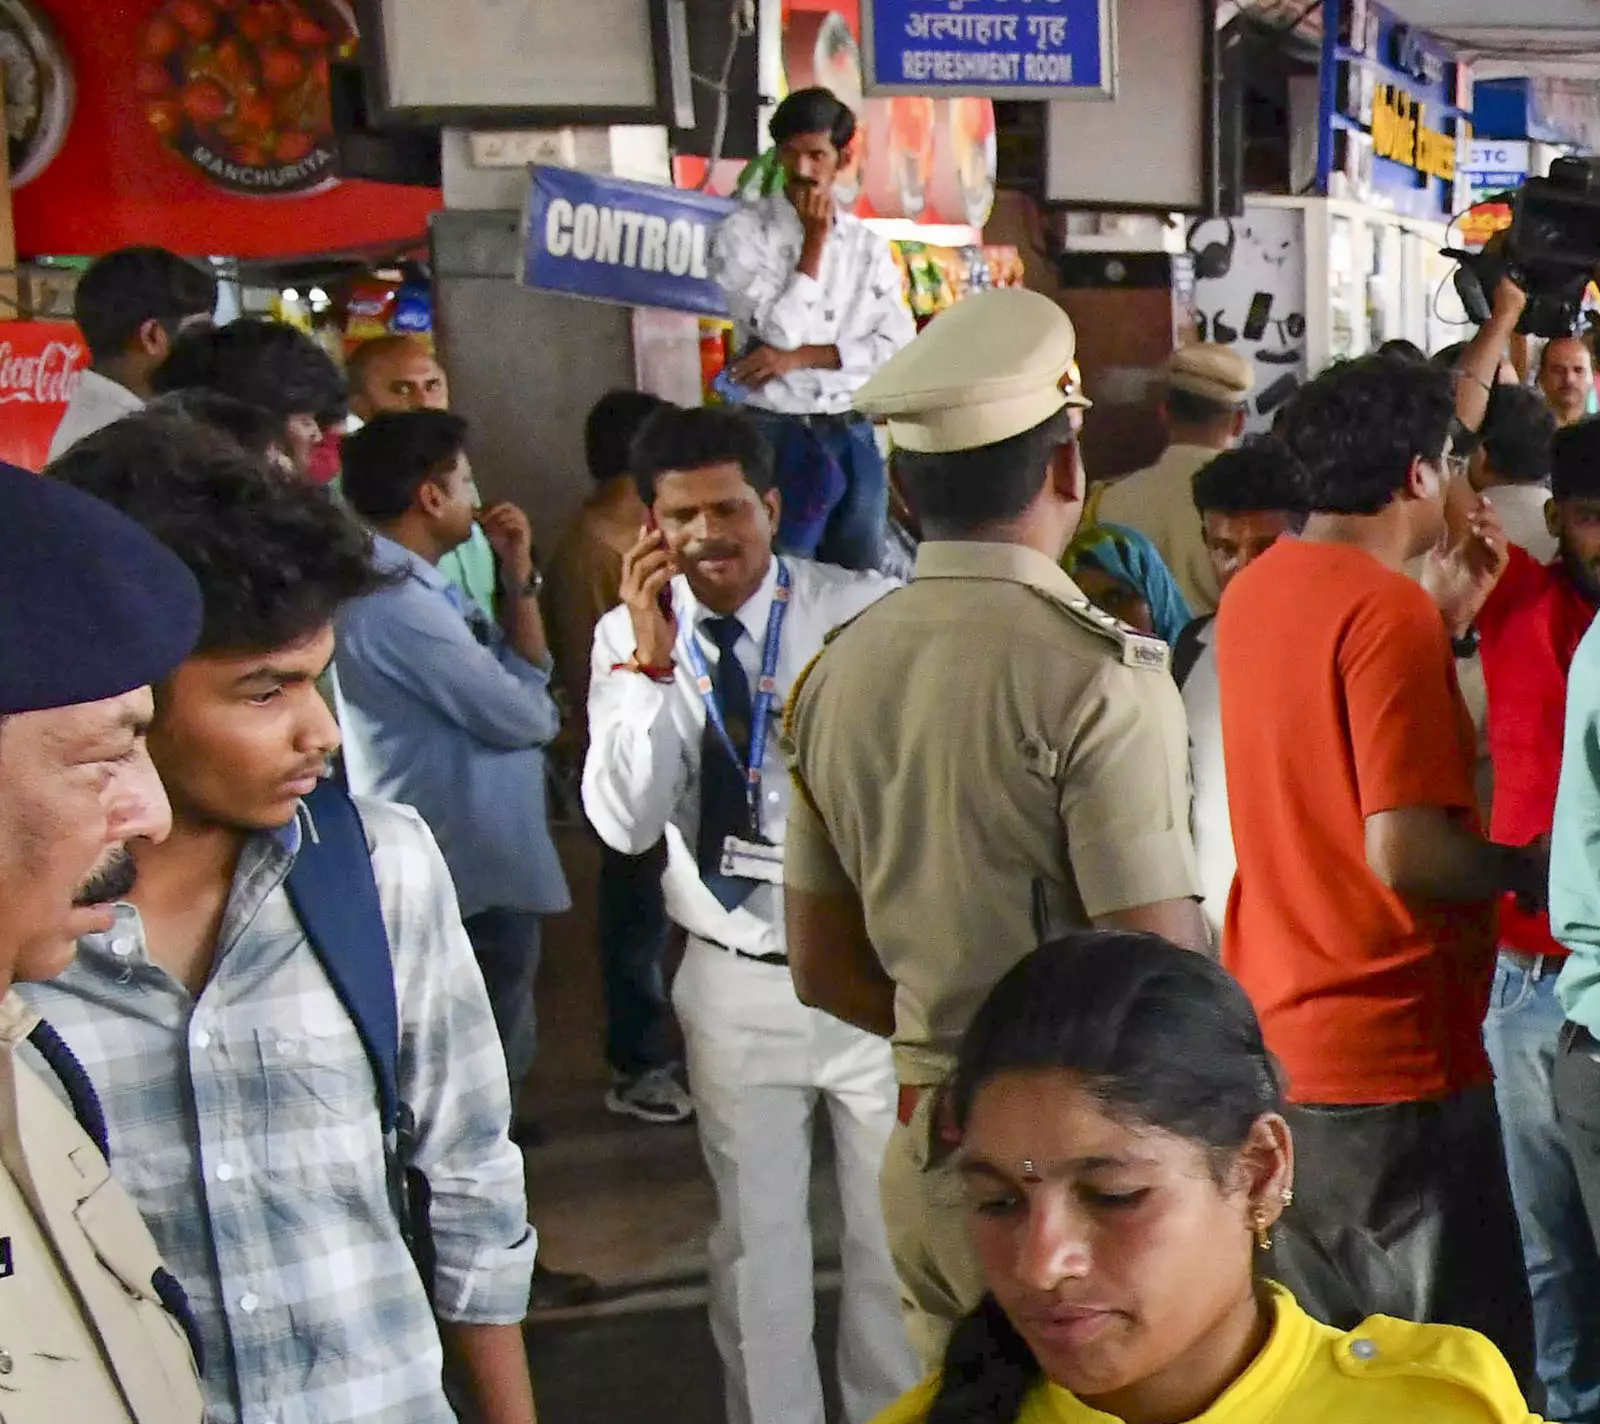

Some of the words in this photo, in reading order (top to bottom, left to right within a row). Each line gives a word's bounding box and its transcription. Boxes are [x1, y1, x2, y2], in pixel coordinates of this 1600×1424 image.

[904, 12, 1019, 45] अल्पाहार
[1026, 15, 1068, 49] गृह
[902, 50, 1020, 81] REFRESHMENT
[1024, 52, 1073, 82] ROOM
[545, 198, 708, 280] CONTROL
